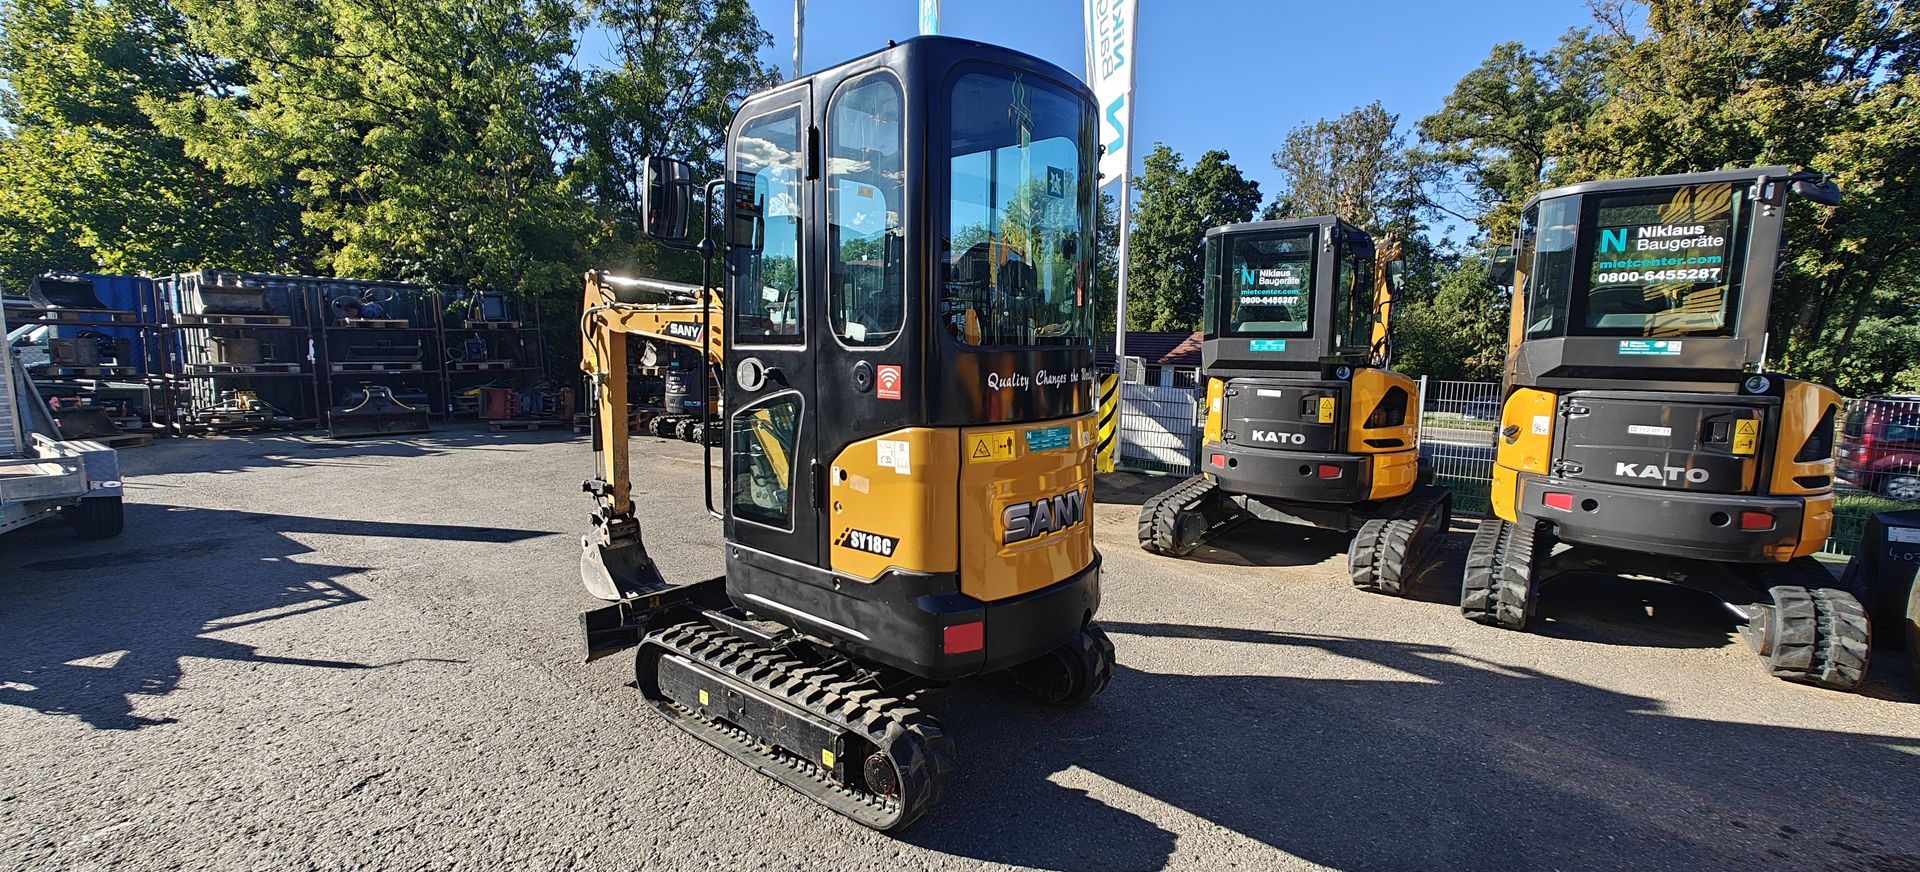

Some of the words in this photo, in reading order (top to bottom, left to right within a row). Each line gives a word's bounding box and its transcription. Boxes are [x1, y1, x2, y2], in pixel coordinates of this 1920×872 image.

[1638, 225, 1705, 238] Niklaus
[1600, 228, 1628, 253] N
[1636, 236, 1725, 251] Baugeräte
[1599, 256, 1722, 269] mietcenter.com
[1241, 270, 1255, 285] N
[1259, 269, 1291, 277] Niklaus
[1598, 268, 1721, 283] 0800-6455287
[1259, 277, 1300, 286] Baugeräte
[670, 323, 699, 338] SANY
[987, 372, 1030, 391] Quality
[1035, 369, 1067, 389] Changes
[1070, 367, 1079, 382] the
[1026, 431, 1032, 439] N
[1252, 430, 1306, 445] KATO
[1615, 462, 1710, 483] KATO
[1003, 486, 1088, 544] SANY
[850, 530, 892, 556] SY18C
